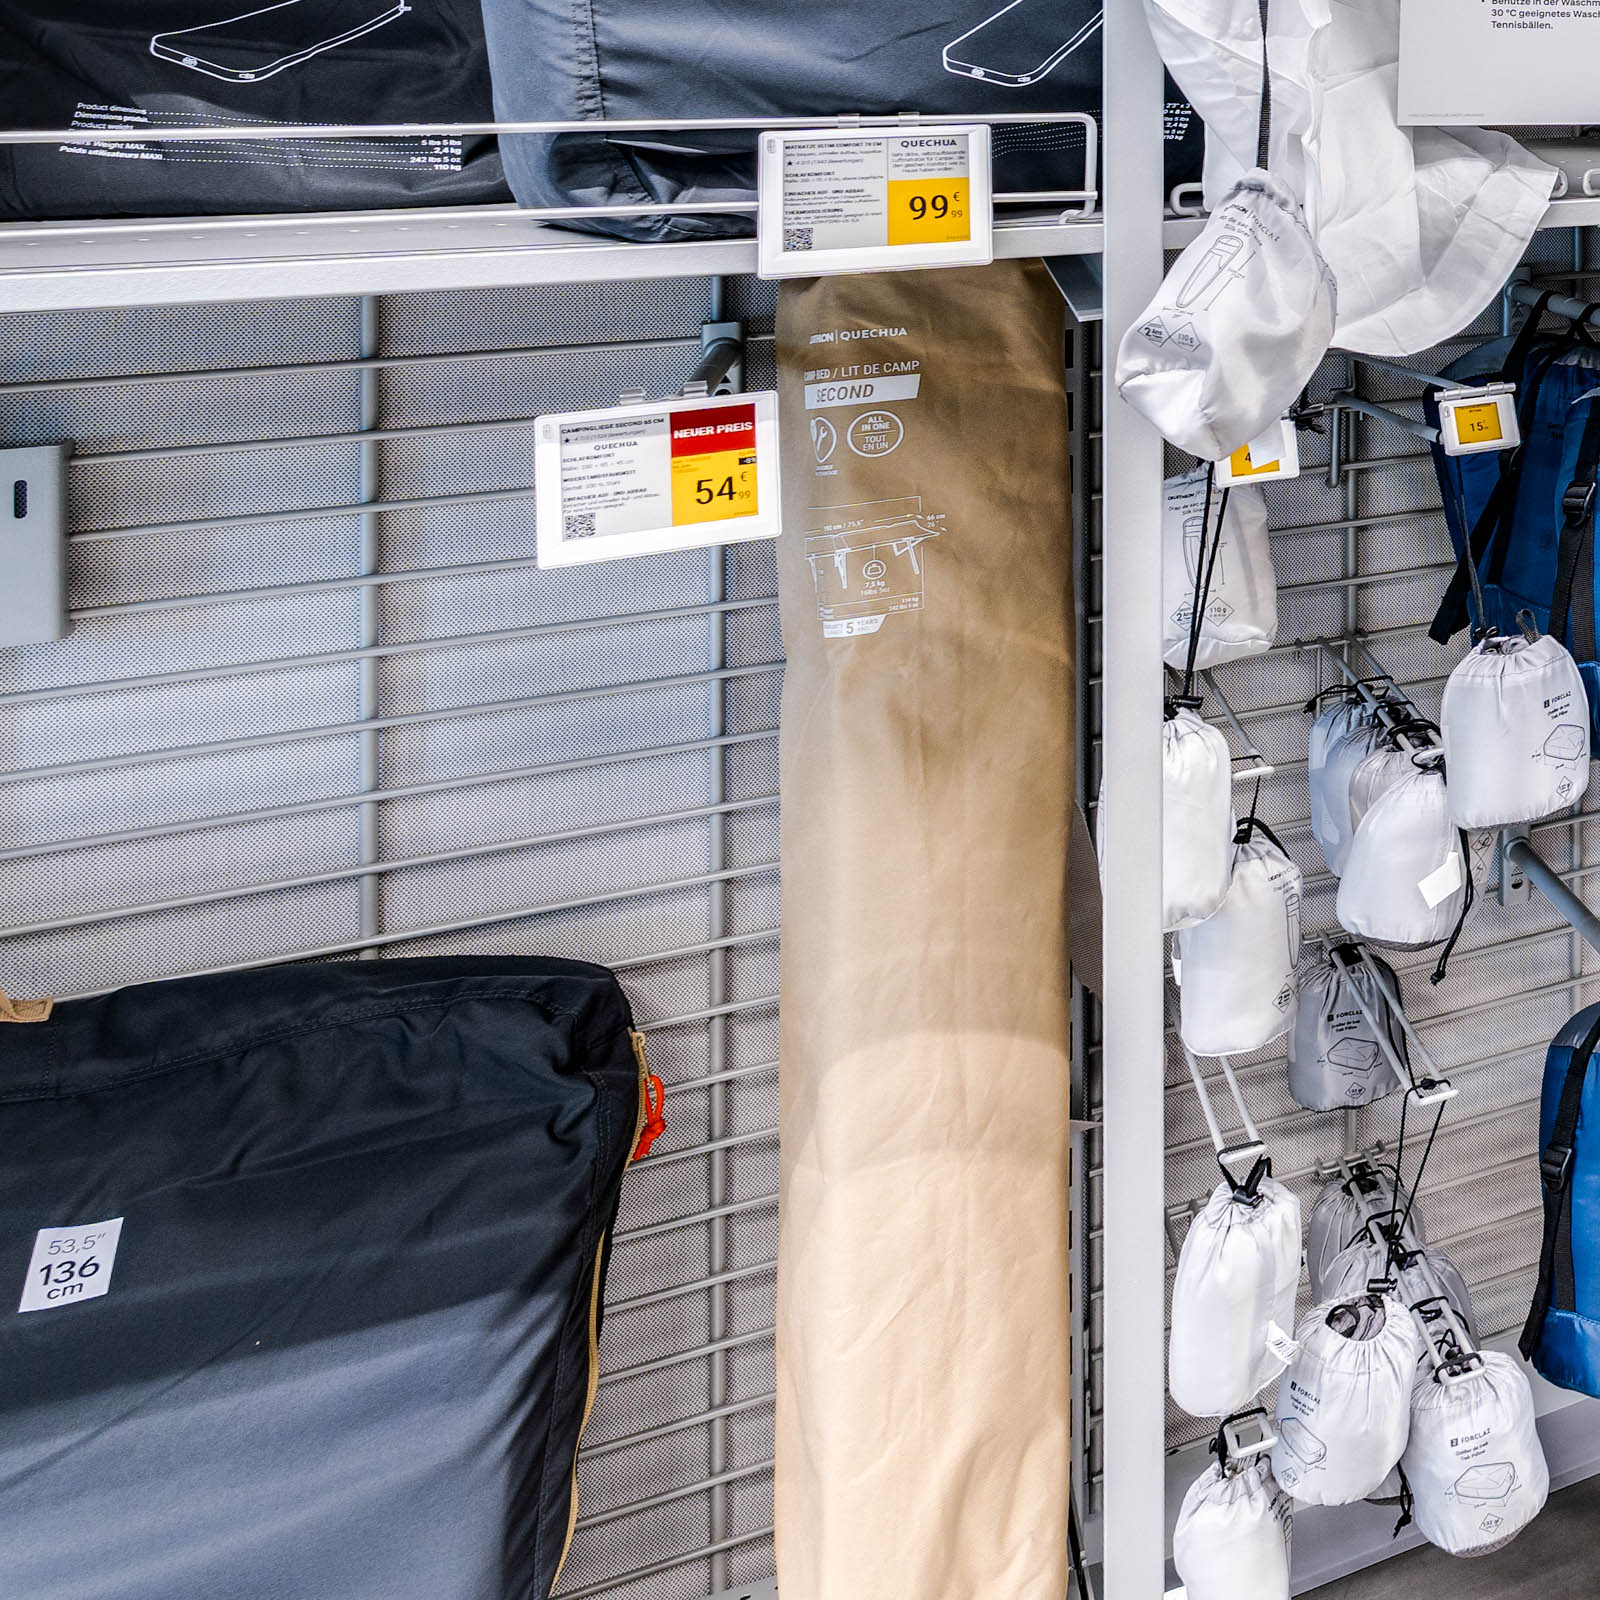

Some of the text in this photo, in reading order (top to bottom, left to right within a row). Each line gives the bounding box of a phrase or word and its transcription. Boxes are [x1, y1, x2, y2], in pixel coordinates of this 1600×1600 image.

[901, 139, 957, 148] QUECHUA
[909, 192, 960, 220] 99 €
[951, 210, 962, 218] 99
[840, 328, 907, 340] QUECHUA
[816, 368, 830, 380] BED
[833, 367, 838, 379] /
[842, 365, 860, 377] LIT
[863, 364, 880, 375] DE
[884, 360, 920, 373] CAMP
[817, 384, 873, 402] SECOND
[674, 422, 752, 439] NEUER PREIS
[873, 421, 890, 429] ONE
[1469, 422, 1483, 431] 15
[864, 435, 886, 443] TOUT
[594, 441, 638, 451] QUECHUA
[863, 441, 889, 451] EN UN
[696, 471, 749, 505] 54 €
[846, 622, 853, 635] 5
[40, 1256, 100, 1286] 136
[47, 1283, 83, 1300] cm
